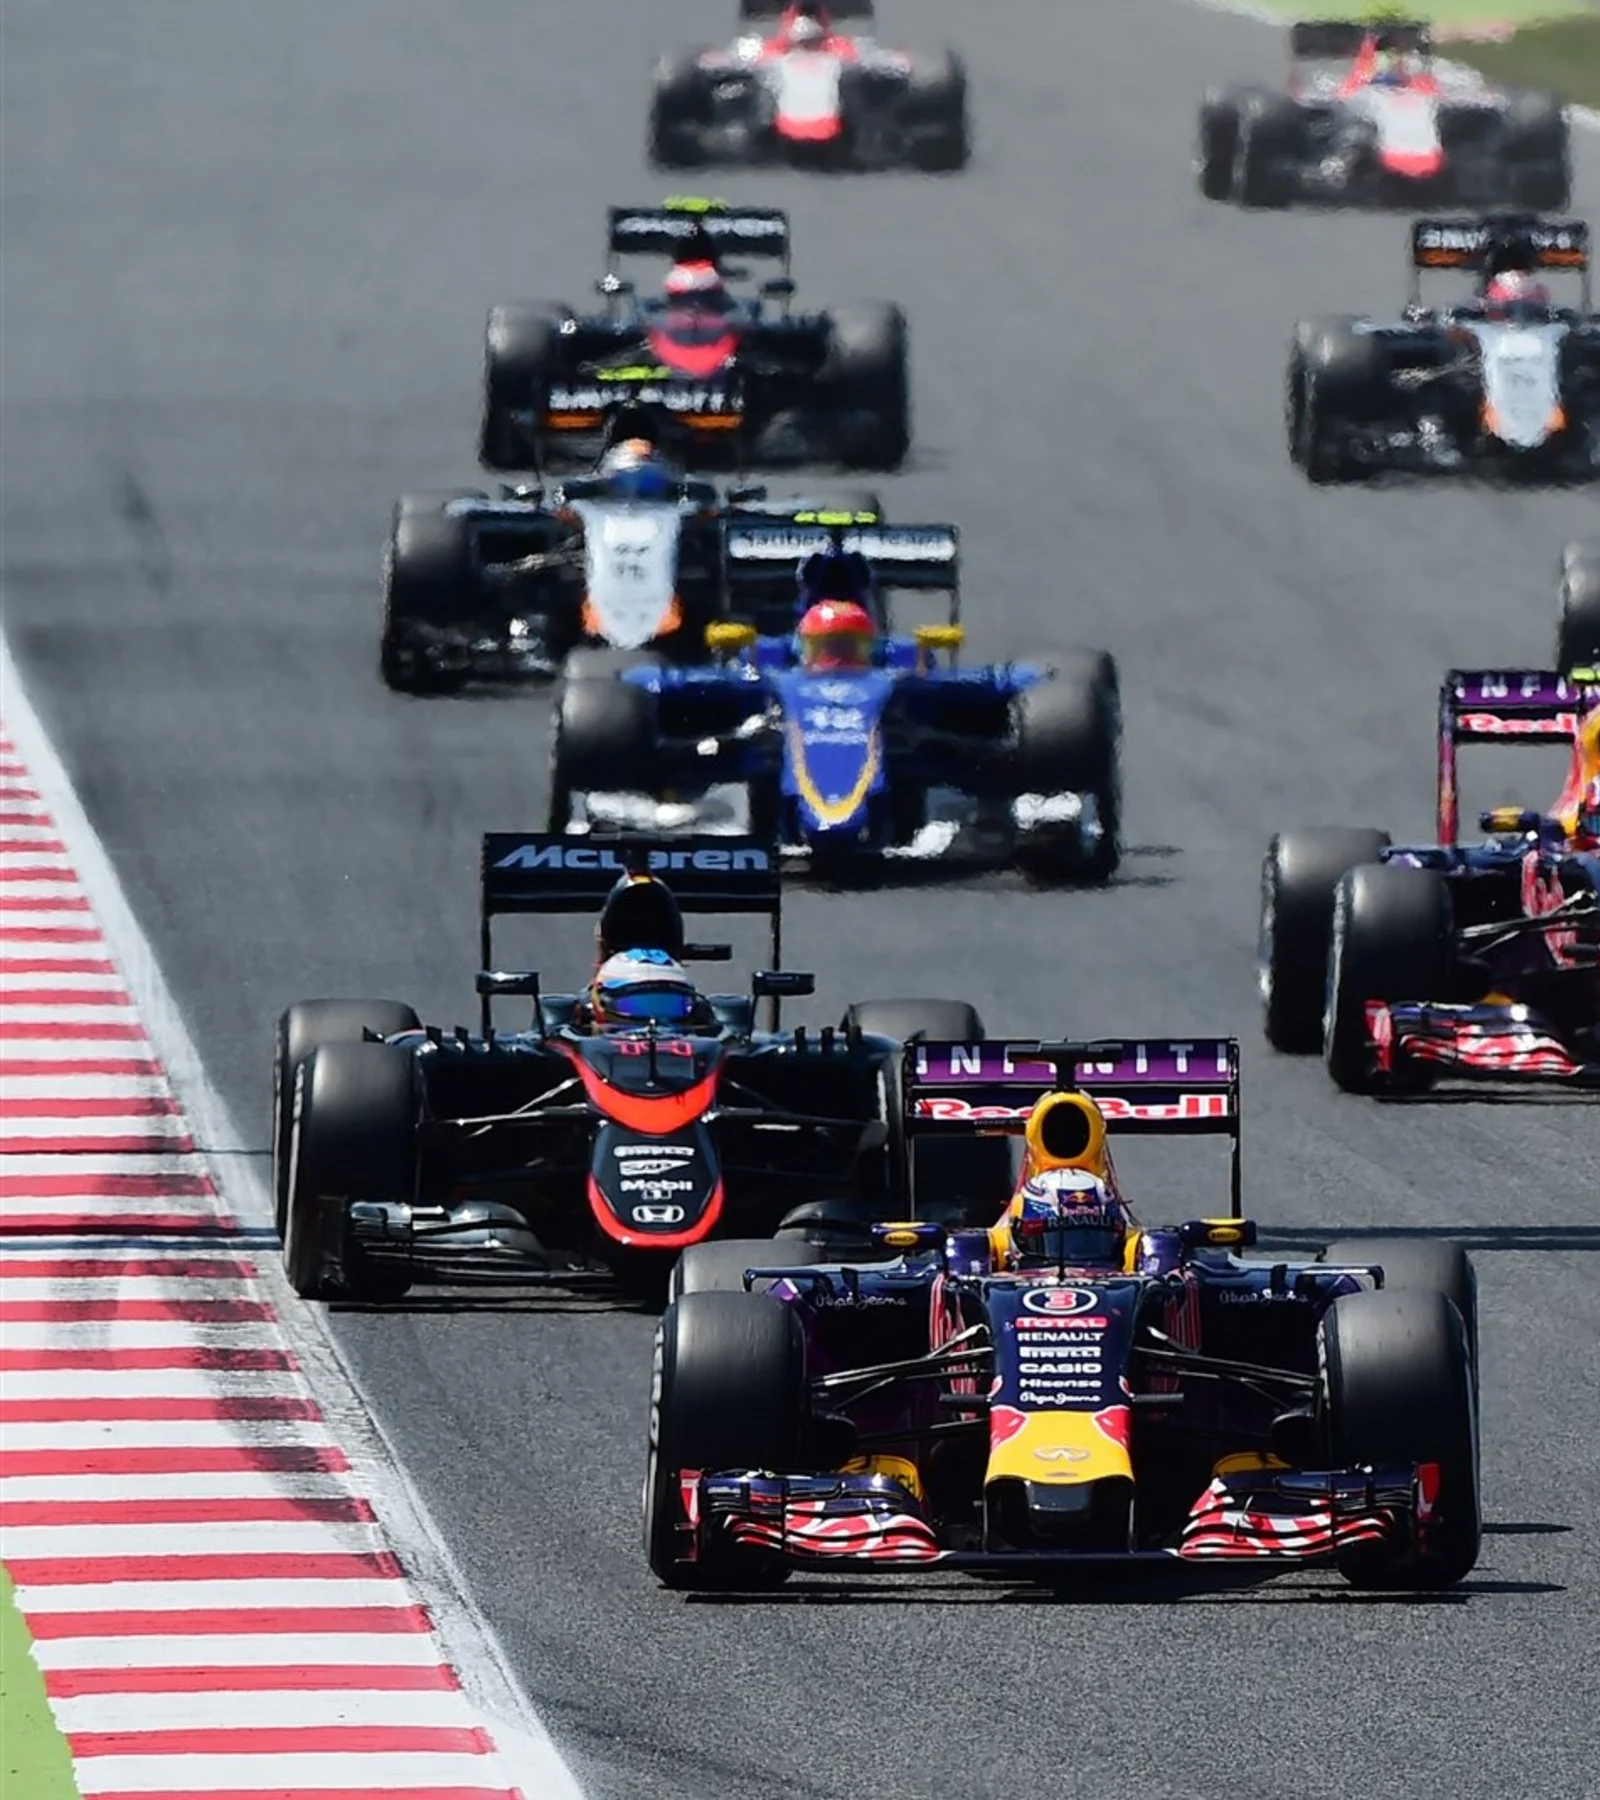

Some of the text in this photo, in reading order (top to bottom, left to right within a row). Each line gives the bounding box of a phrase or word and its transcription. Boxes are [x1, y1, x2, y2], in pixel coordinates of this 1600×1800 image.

[916, 1045, 1226, 1074] INITI
[917, 1098, 1032, 1119] Re
[620, 1179, 693, 1191] Mobil
[1044, 1291, 1077, 1309] 3
[1018, 1317, 1105, 1329] TOTAL
[1017, 1332, 1104, 1342] RENAULT
[1019, 1363, 1102, 1374] CASIO
[1019, 1379, 1102, 1388] Hisense
